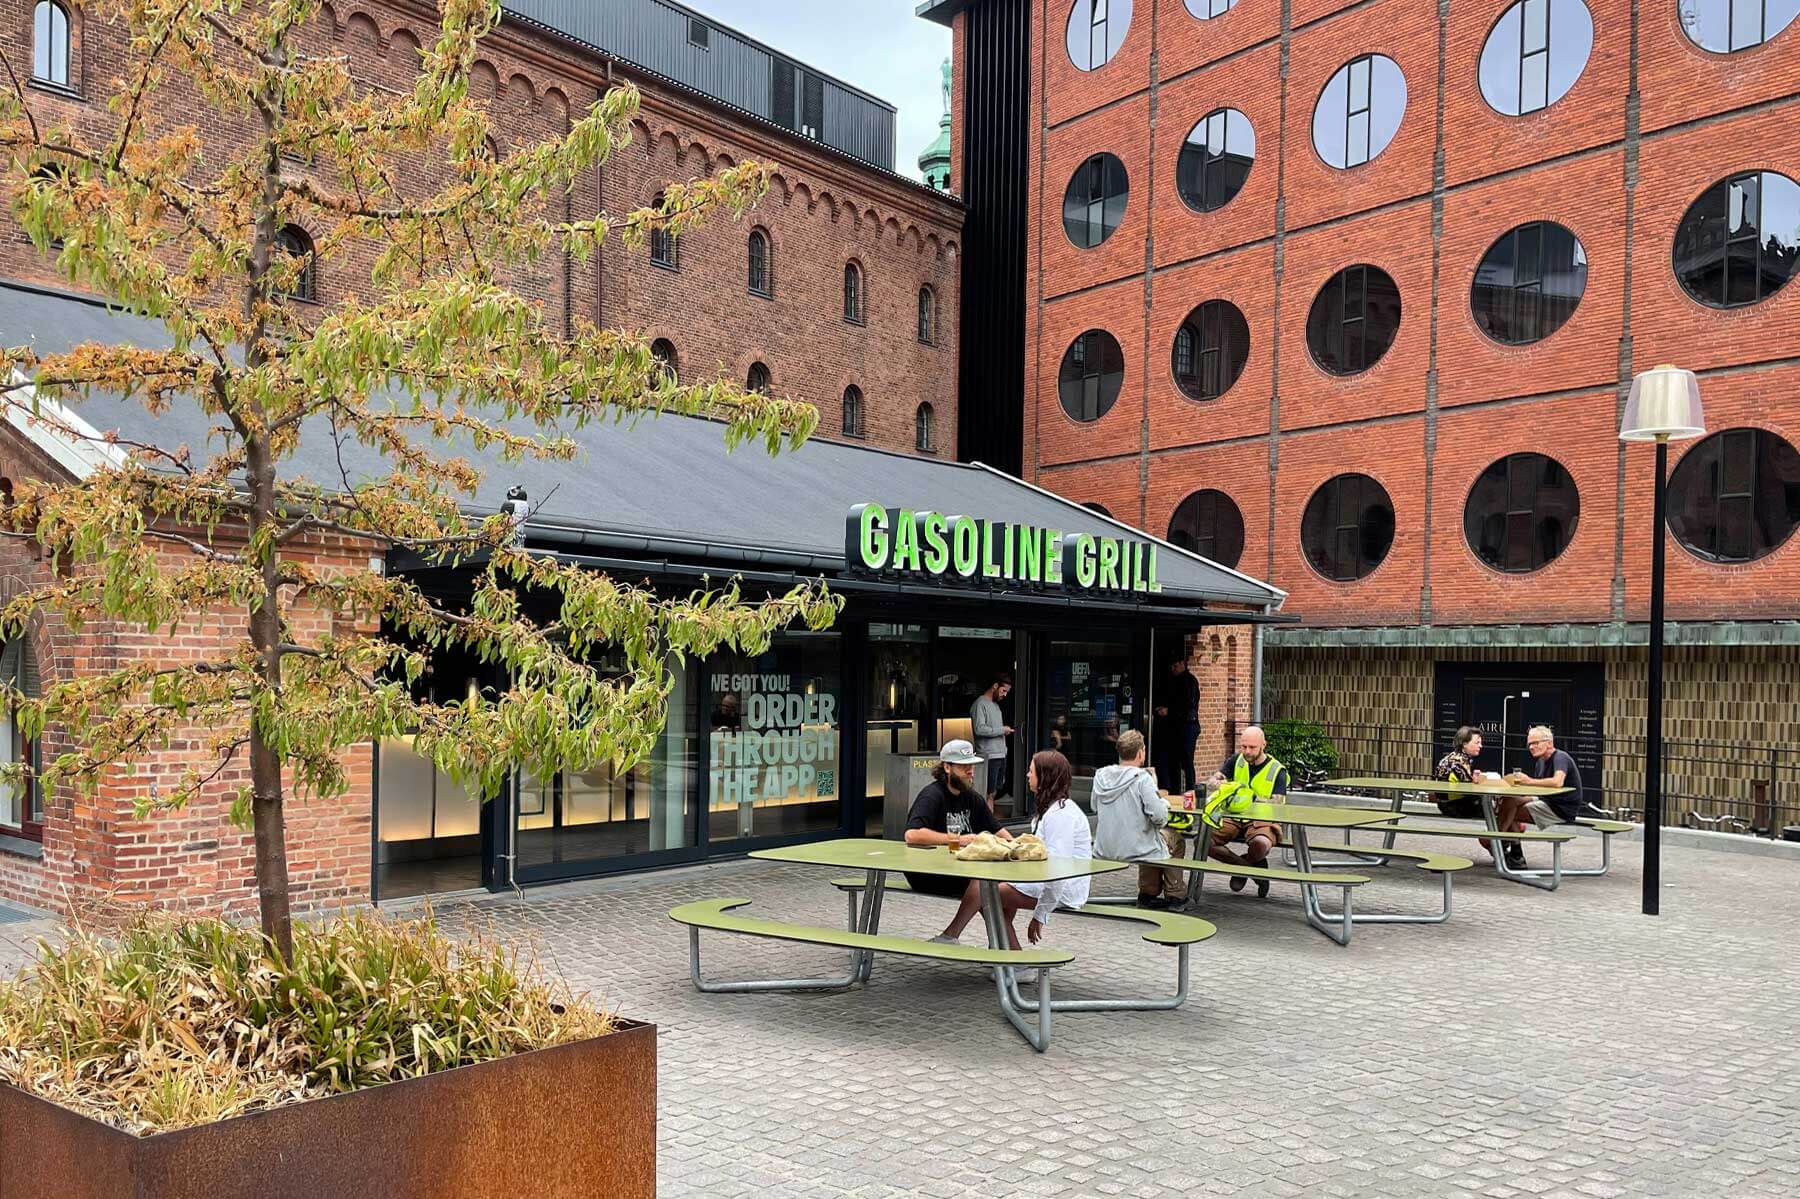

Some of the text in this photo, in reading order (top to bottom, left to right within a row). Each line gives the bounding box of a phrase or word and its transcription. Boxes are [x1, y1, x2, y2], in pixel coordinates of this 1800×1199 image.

[859, 503, 1162, 593] GASOLINE GRILL
[732, 674, 759, 692] GOT
[761, 674, 791, 692] YOU!
[747, 693, 837, 729] ORDER
[710, 728, 835, 769] THROUGH
[709, 764, 816, 805] THE APP
